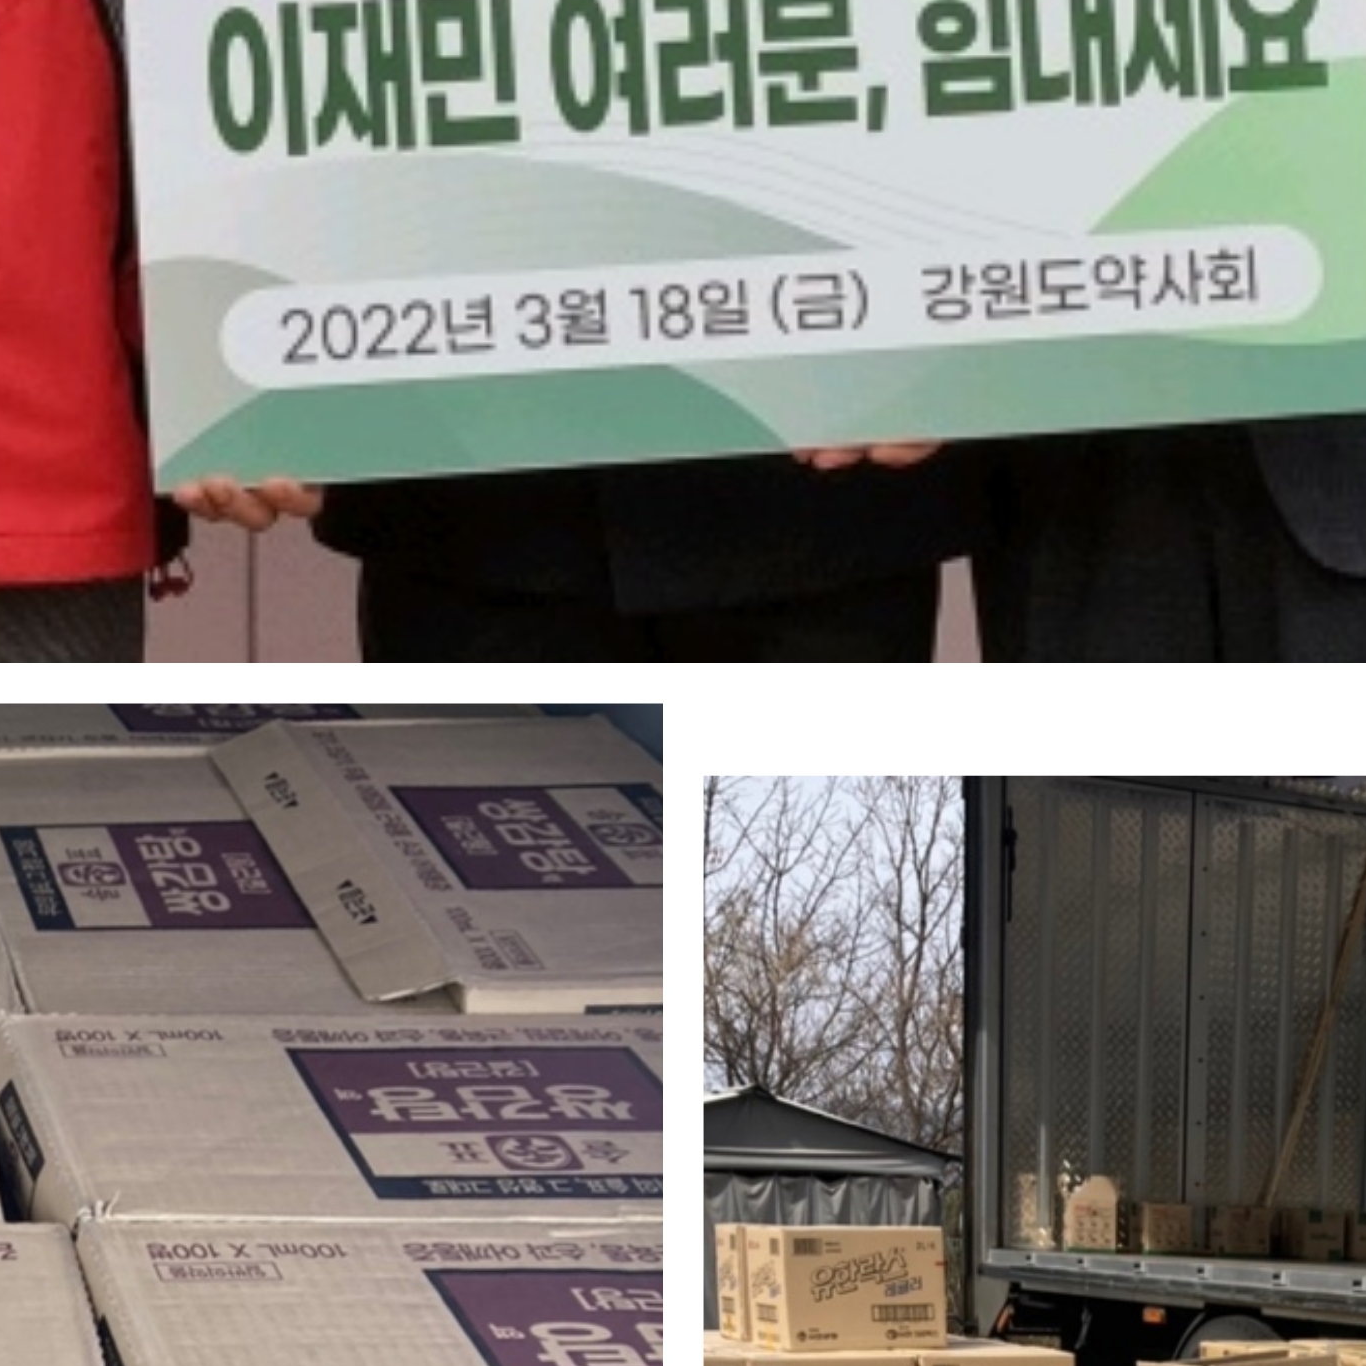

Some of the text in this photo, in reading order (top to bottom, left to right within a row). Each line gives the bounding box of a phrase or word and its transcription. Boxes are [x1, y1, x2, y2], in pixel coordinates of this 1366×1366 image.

[281, 244, 1259, 366] 2022년 3월 18일 (금) 강원도약사회
